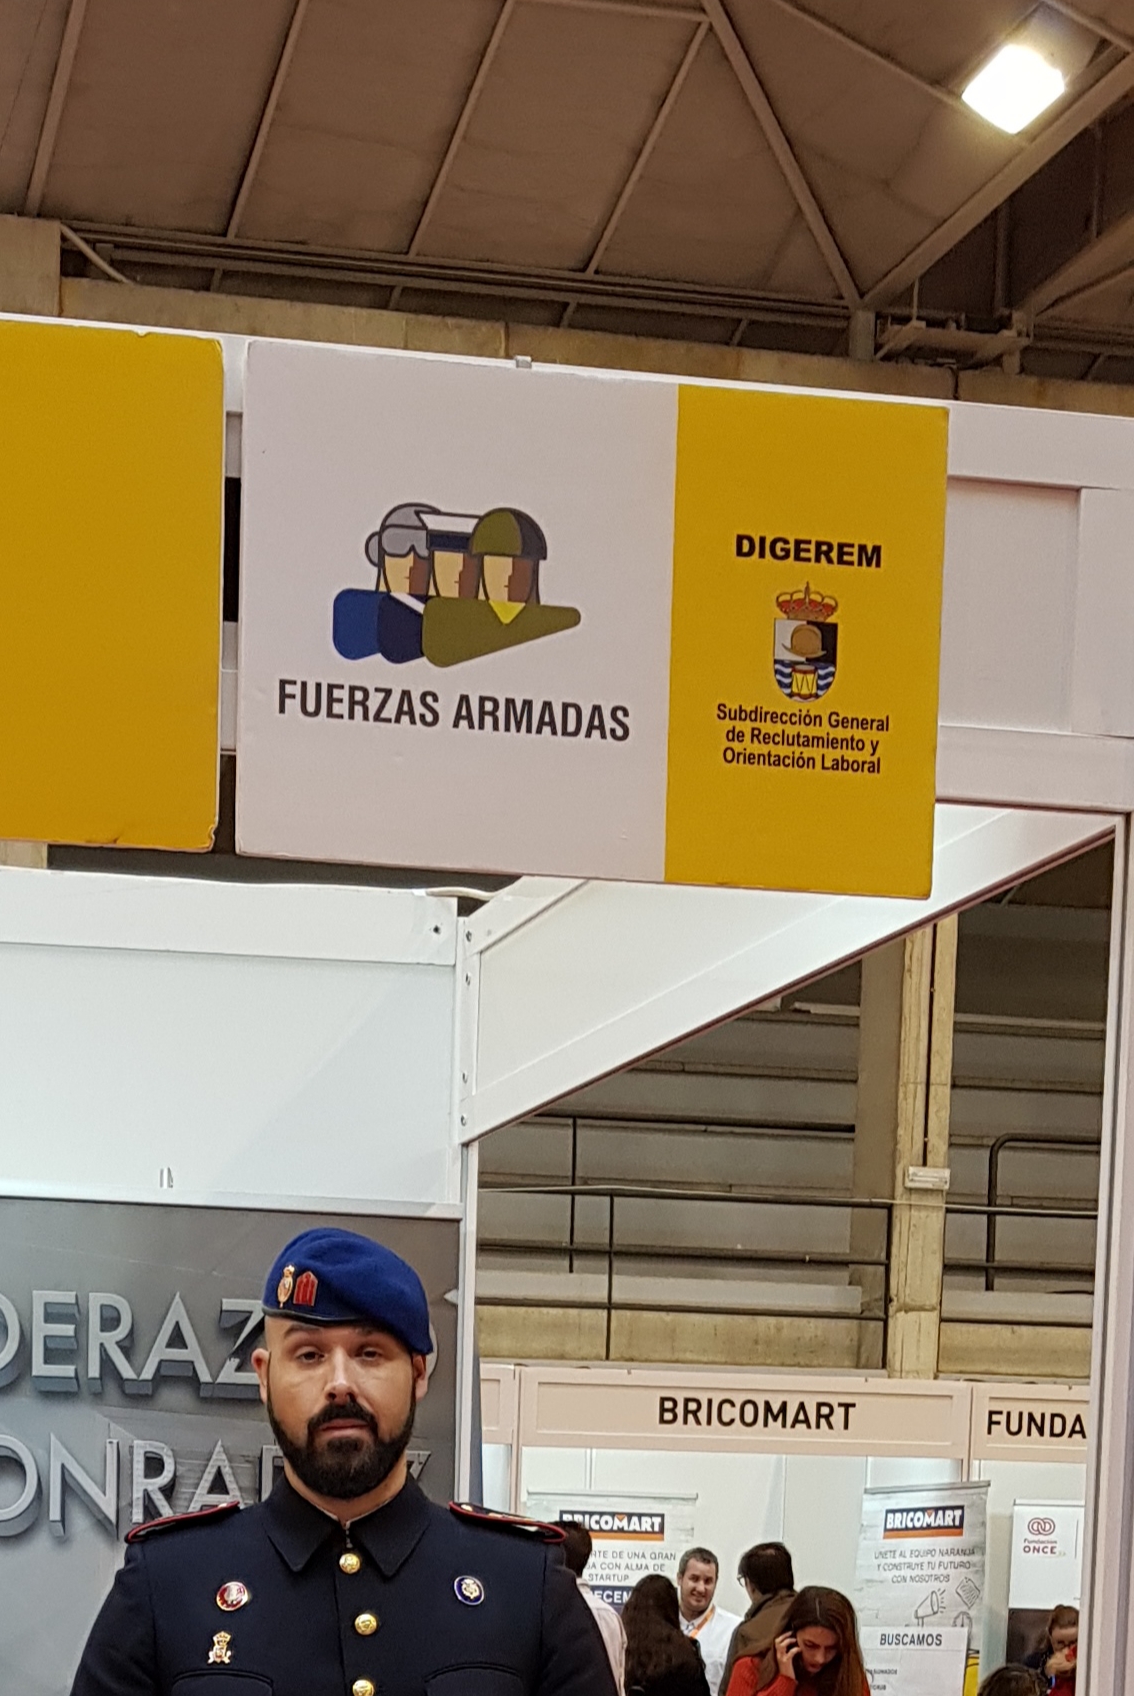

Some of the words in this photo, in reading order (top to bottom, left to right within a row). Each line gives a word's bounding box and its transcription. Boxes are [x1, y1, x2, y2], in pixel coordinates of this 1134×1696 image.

[735, 533, 883, 568] DIGEREM
[277, 679, 440, 727] FUERZAS
[452, 694, 631, 742] ARMADAS
[716, 703, 824, 728] Subdirección
[828, 711, 890, 733] General
[725, 726, 747, 744] de
[750, 728, 866, 752] Reclutamiento
[869, 738, 880, 756] y
[722, 748, 817, 770] Orientación
[820, 754, 881, 774] Laboral
[658, 1395, 857, 1431] BRICOMART
[986, 1409, 1087, 1440] FUNDA
[885, 1509, 963, 1530] BRICOMART
[612, 1550, 624, 1559] DE
[627, 1551, 646, 1560] UNA
[649, 1551, 677, 1561] GRAN
[898, 1549, 907, 1559] AL
[909, 1548, 936, 1558] EQUIPO
[1023, 1545, 1058, 1555] ONCE
[600, 1562, 622, 1571] CON
[624, 1562, 650, 1572] ALMA
[652, 1563, 666, 1572] DE
[883, 1561, 925, 1571] CONSTRUYE
[938, 1560, 971, 1570] FUTURO
[588, 1573, 630, 1583] STARTUP
[891, 1574, 908, 1584] CON
[909, 1574, 951, 1583] NOSOTROS
[879, 1633, 943, 1647] BUSCAMOS
